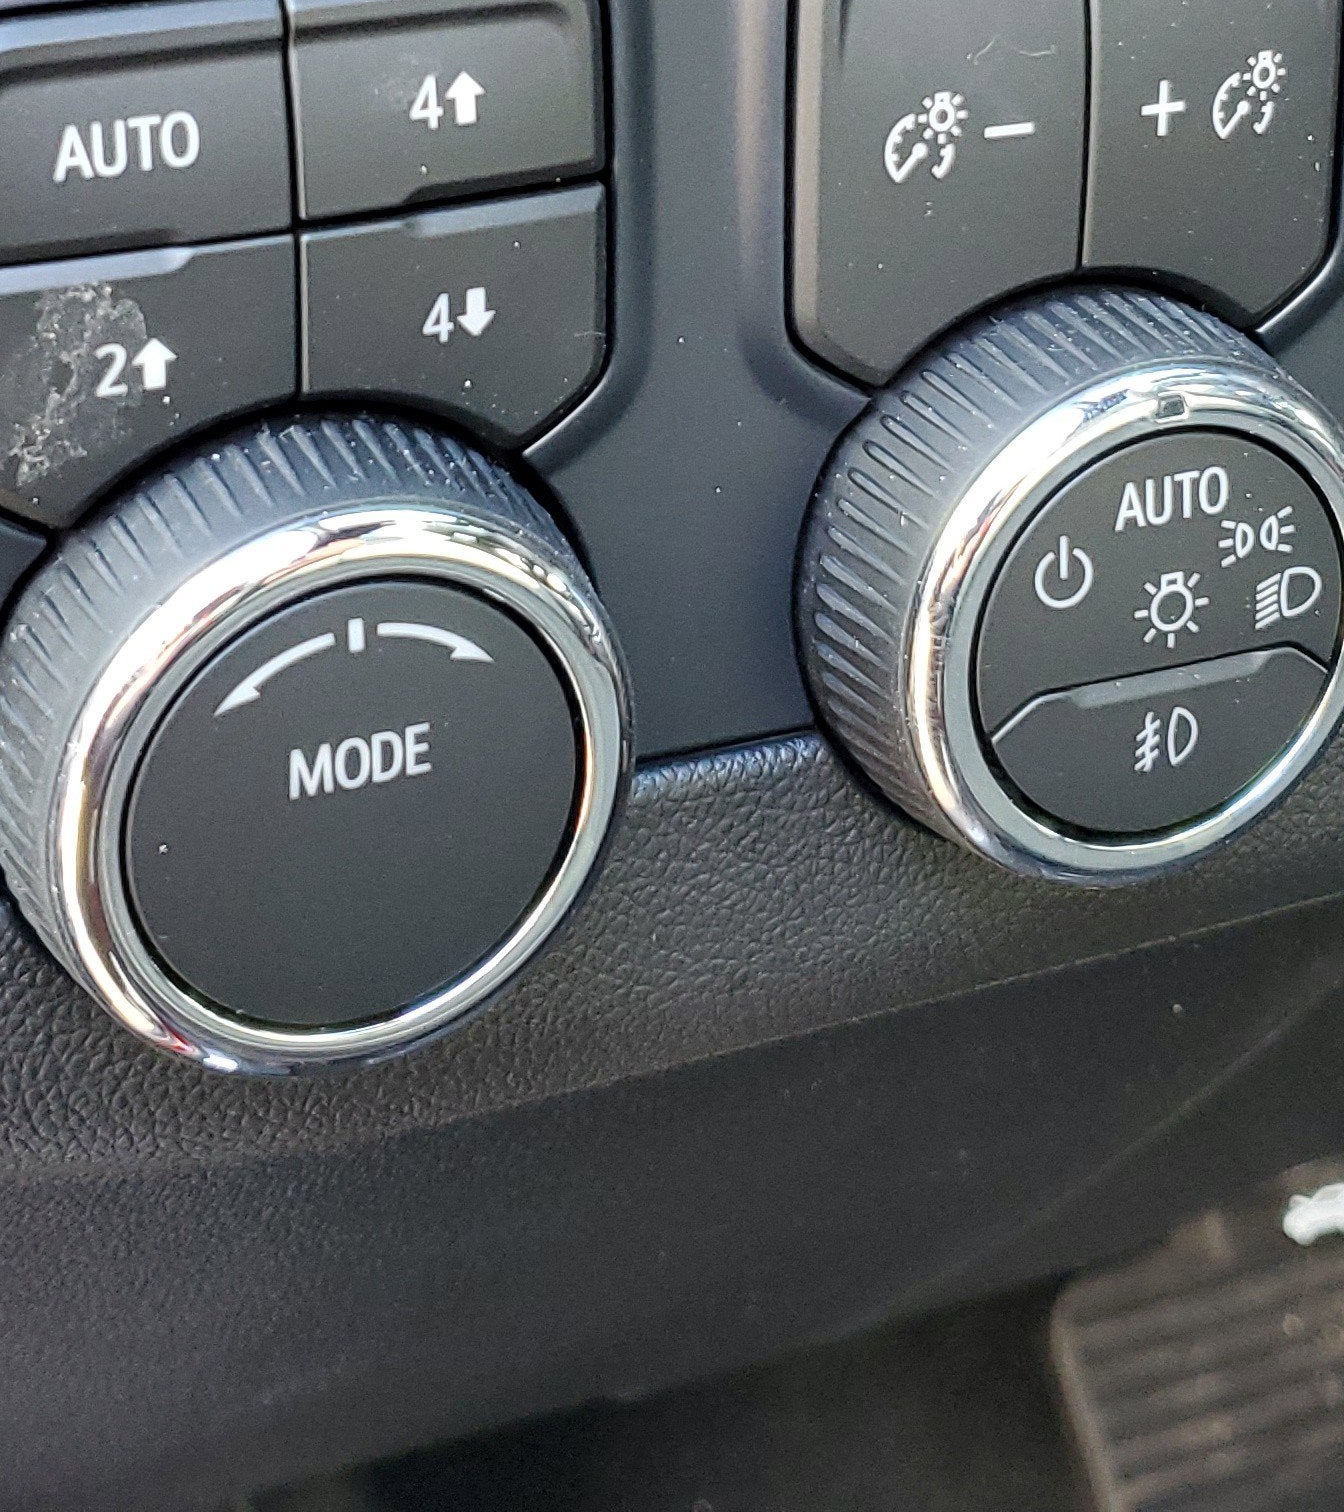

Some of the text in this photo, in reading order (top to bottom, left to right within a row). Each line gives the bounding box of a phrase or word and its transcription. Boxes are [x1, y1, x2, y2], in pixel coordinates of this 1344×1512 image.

[53, 111, 200, 182] AUTO
[1114, 466, 1229, 532] AUTO
[288, 721, 432, 801] MODE
